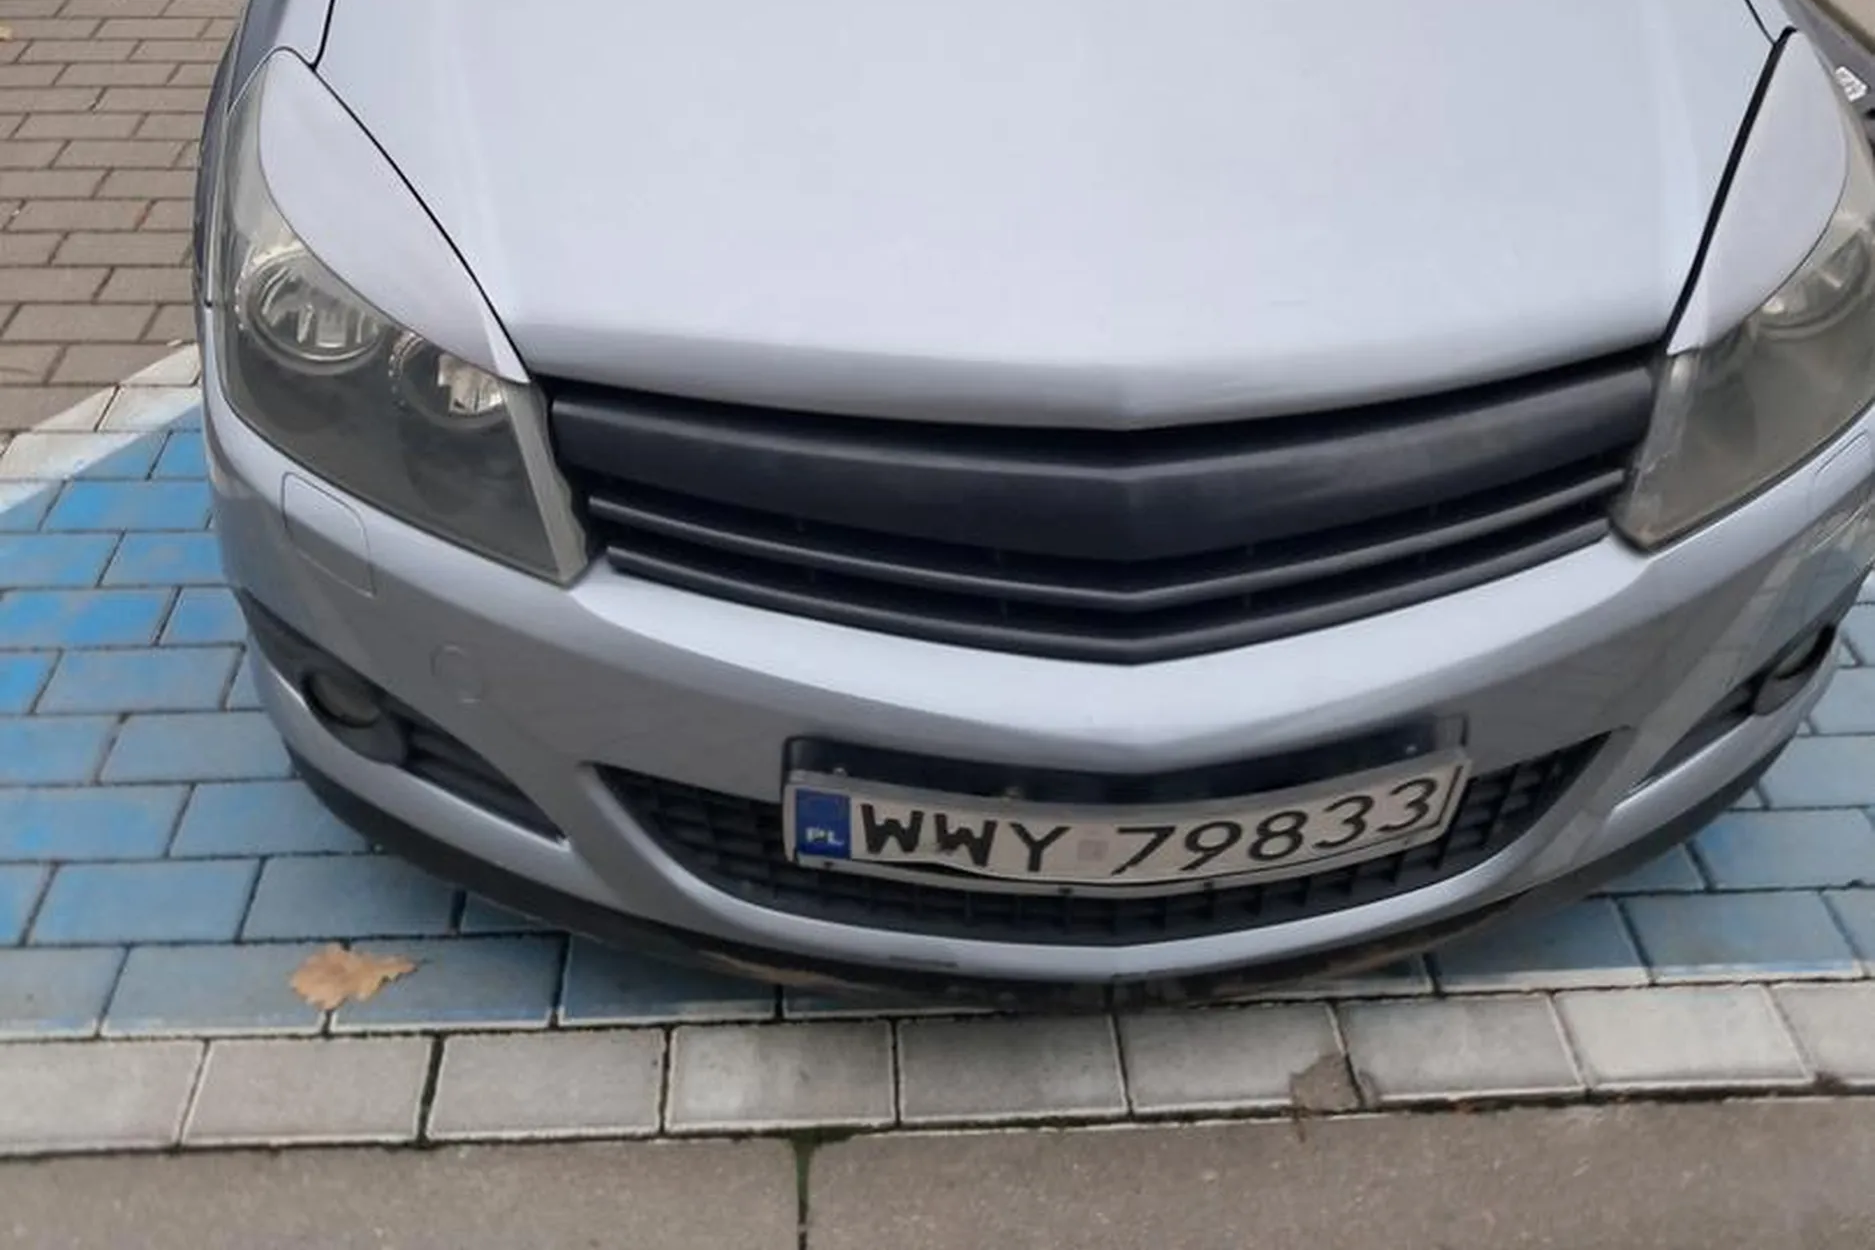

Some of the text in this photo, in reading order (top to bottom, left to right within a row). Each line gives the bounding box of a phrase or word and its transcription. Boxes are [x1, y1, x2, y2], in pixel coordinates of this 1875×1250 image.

[805, 826, 844, 846] PL
[861, 777, 1438, 876] WWY 79833
